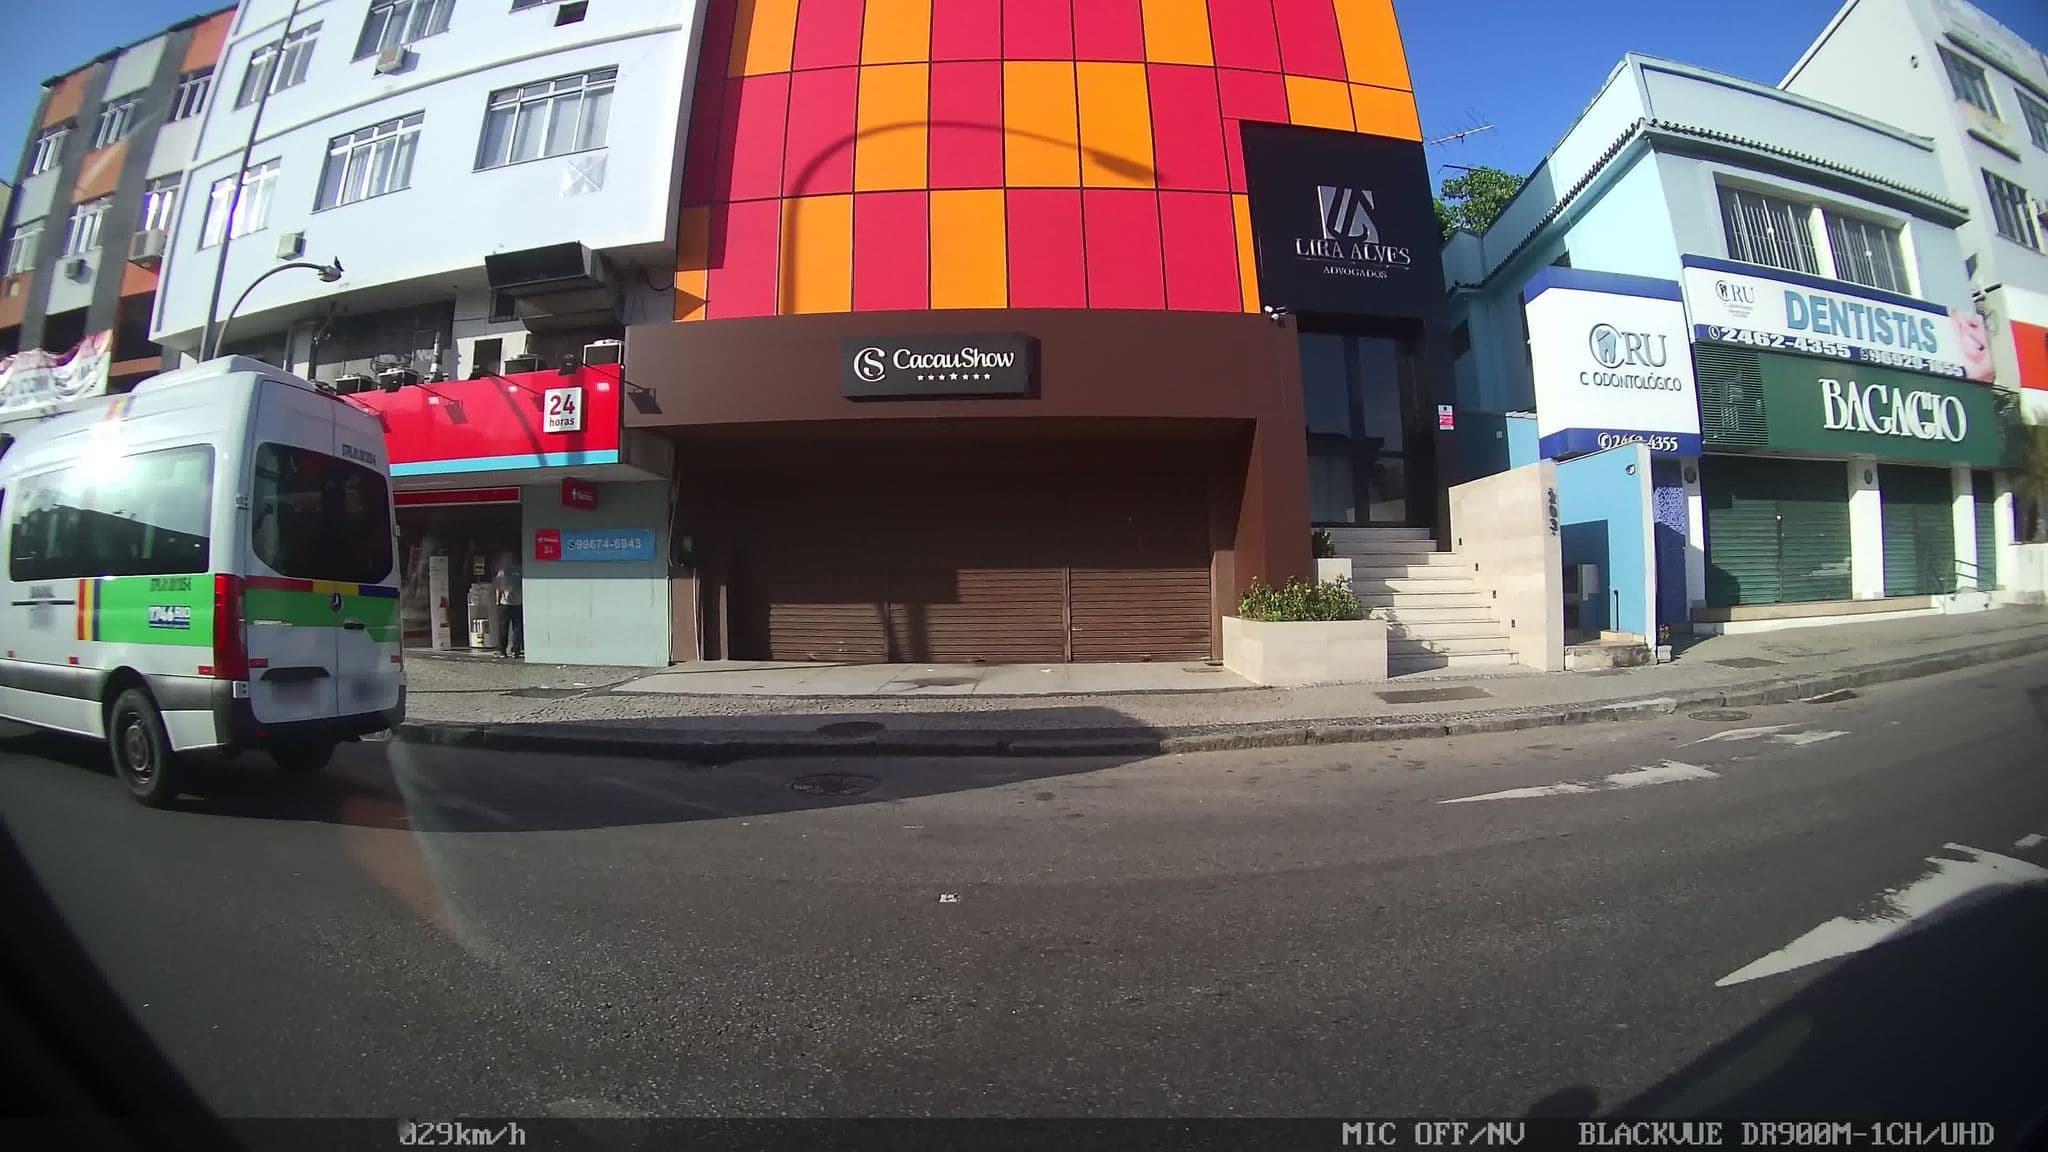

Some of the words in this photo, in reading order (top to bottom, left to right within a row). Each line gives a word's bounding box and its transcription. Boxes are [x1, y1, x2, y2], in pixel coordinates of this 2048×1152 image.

[1296, 238, 1344, 259] LIRA
[1351, 242, 1411, 265] ALVES
[1323, 266, 1387, 279] ADVOGADOS
[1784, 290, 1937, 353] DENTISTAS
[1720, 327, 1852, 358] 2462-4355
[1580, 371, 1589, 386] C
[1593, 371, 1682, 391] ODONTOLÓGICO
[550, 394, 575, 415] 24
[550, 417, 575, 427] horas
